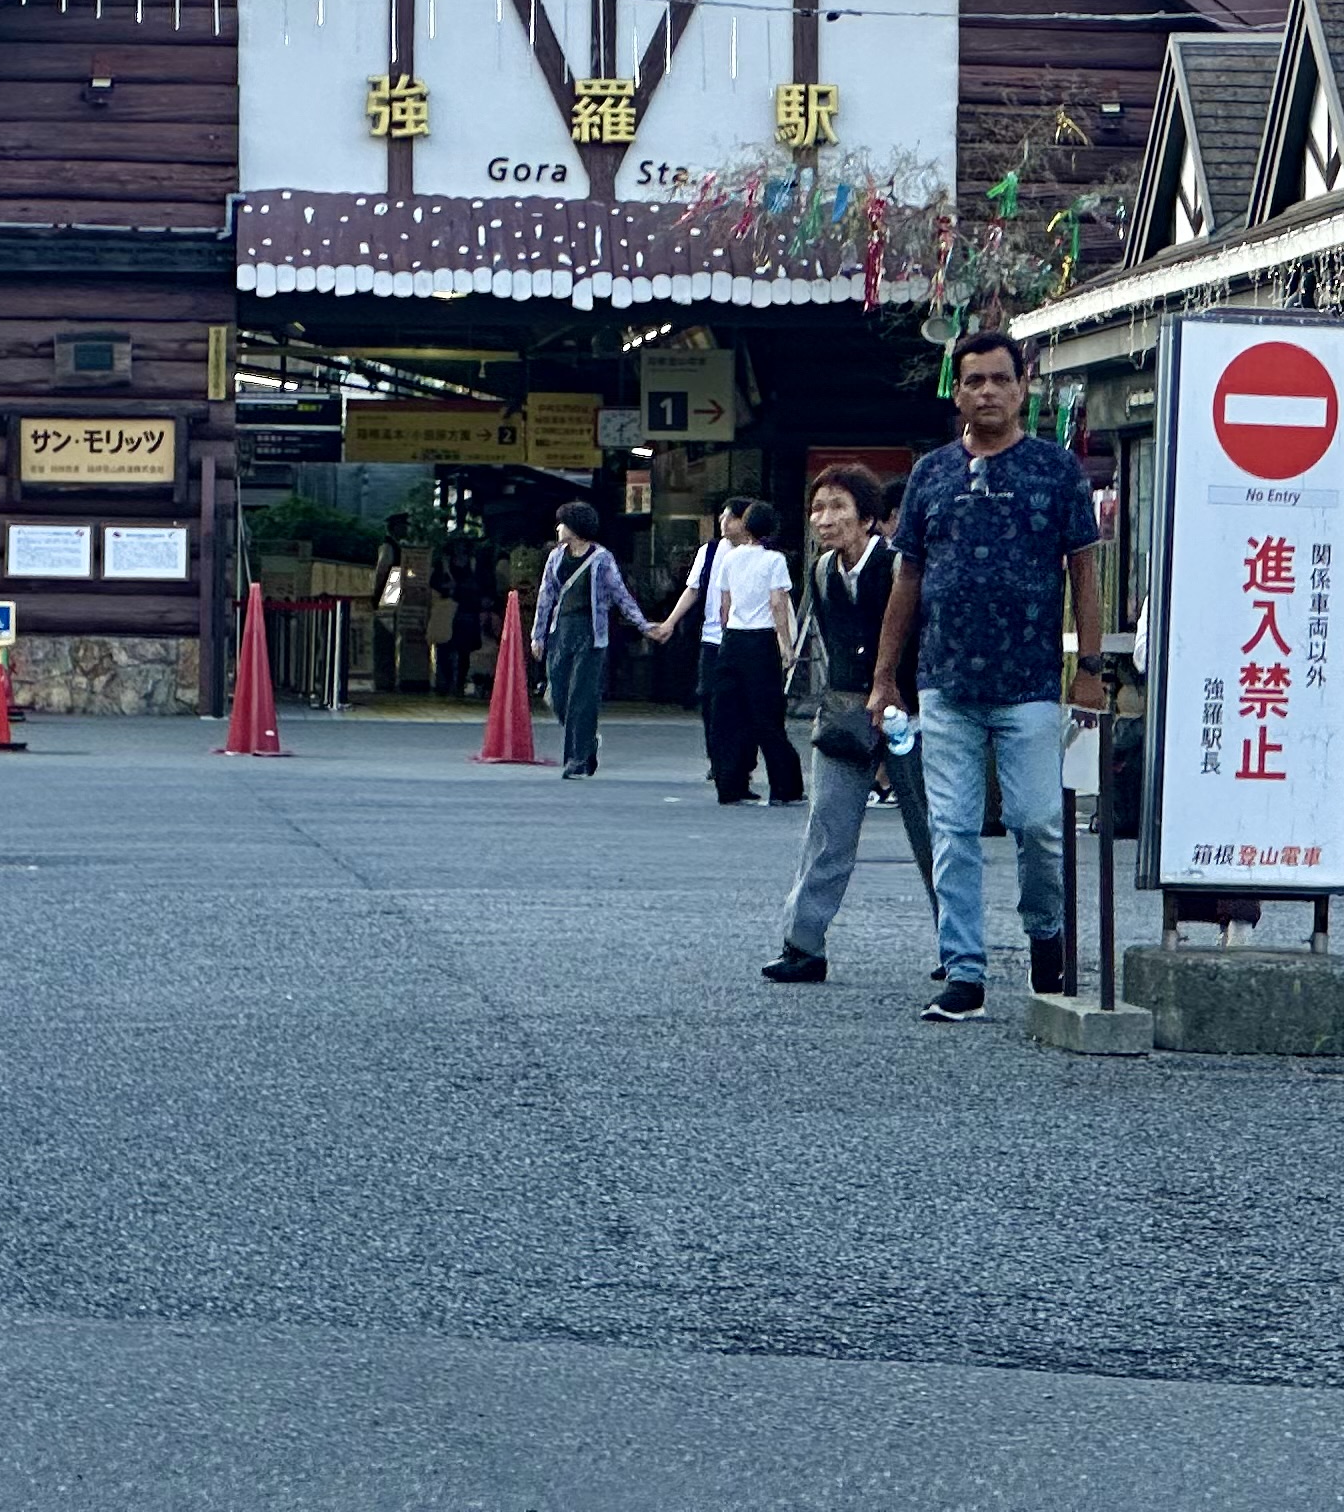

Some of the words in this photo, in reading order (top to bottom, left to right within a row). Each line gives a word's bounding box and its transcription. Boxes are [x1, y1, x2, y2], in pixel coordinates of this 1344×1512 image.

[366, 74, 839, 147] 強羅駅
[488, 157, 568, 183] Gora
[659, 397, 673, 426] 1
[31, 428, 165, 454] サン・モリッツ
[502, 429, 513, 443] 2
[1246, 488, 1265, 503] No
[1268, 489, 1302, 506] Entry
[1306, 542, 1333, 688] 関係車両以外
[1235, 536, 1296, 781] 進入禁止
[1200, 677, 1225, 776] 強羅駅長
[1191, 843, 1323, 867] 箱根登山電車
